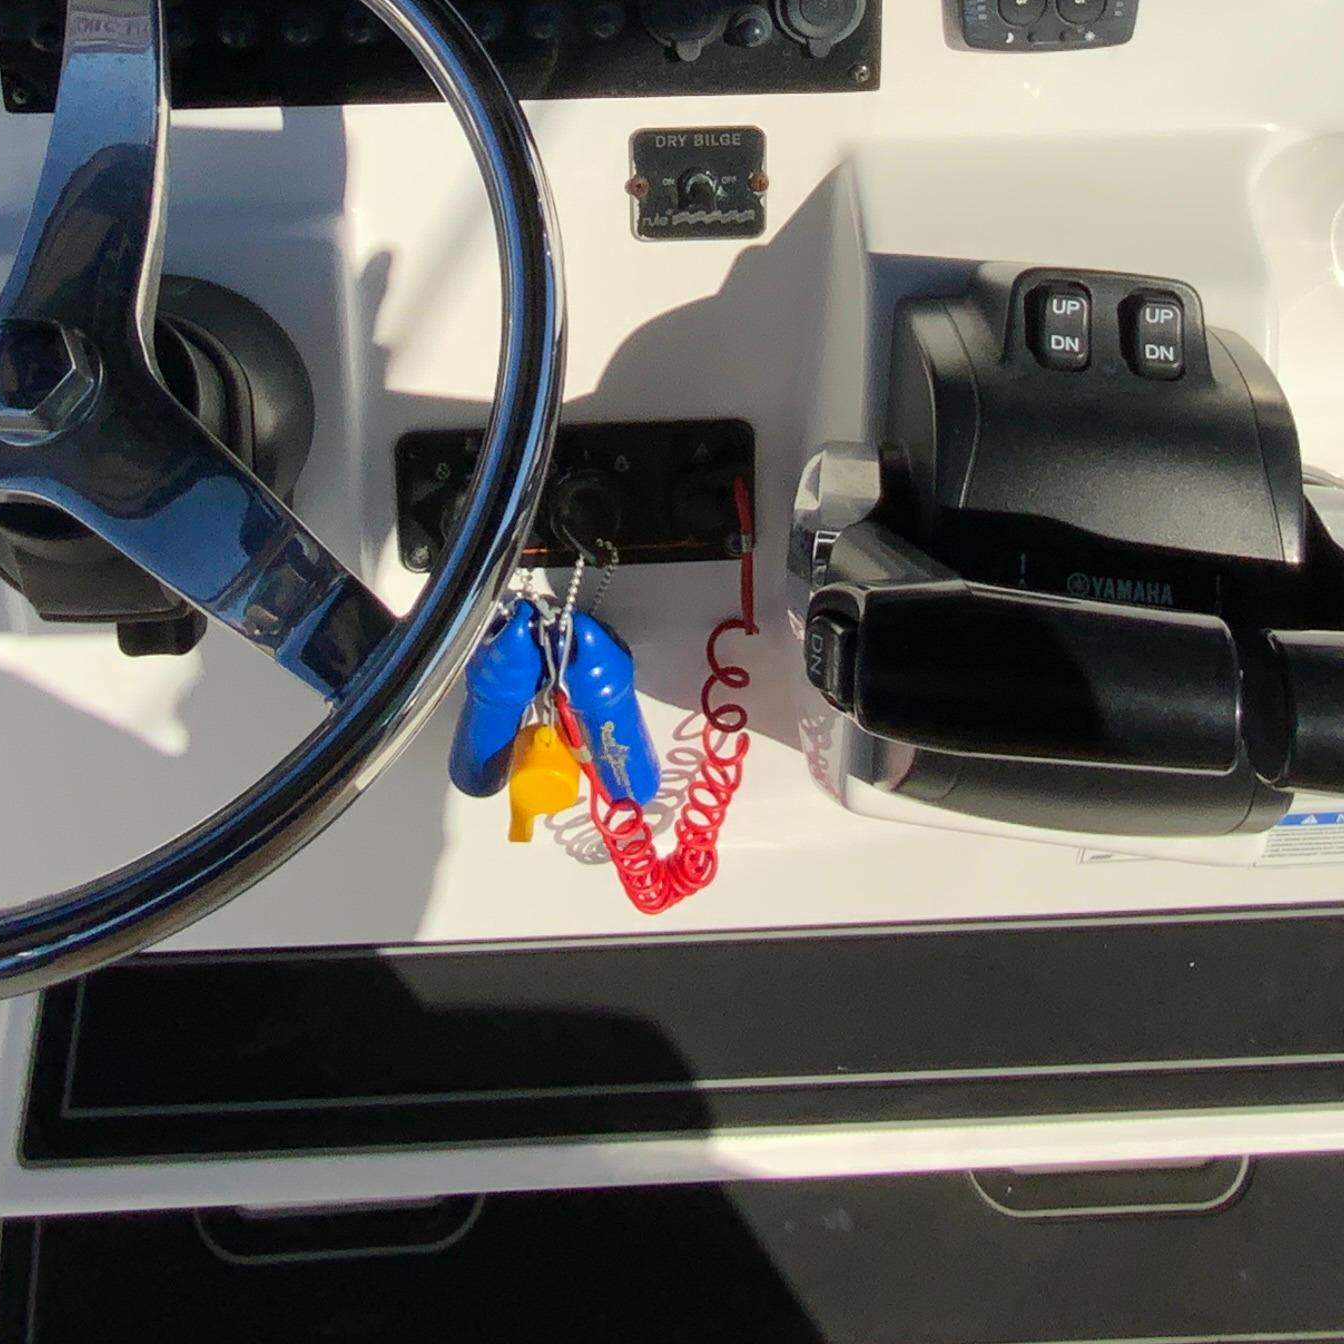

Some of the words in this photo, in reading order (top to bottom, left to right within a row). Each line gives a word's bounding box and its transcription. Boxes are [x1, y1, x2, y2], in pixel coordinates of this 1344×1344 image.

[656, 135, 687, 148] DRY
[694, 133, 742, 146] BILGE
[1052, 298, 1080, 315] UP
[1146, 307, 1174, 324] UP
[1050, 334, 1080, 353] DN
[1145, 343, 1174, 362] DN
[1091, 575, 1174, 606] YAMAHA
[810, 632, 824, 676] DN
